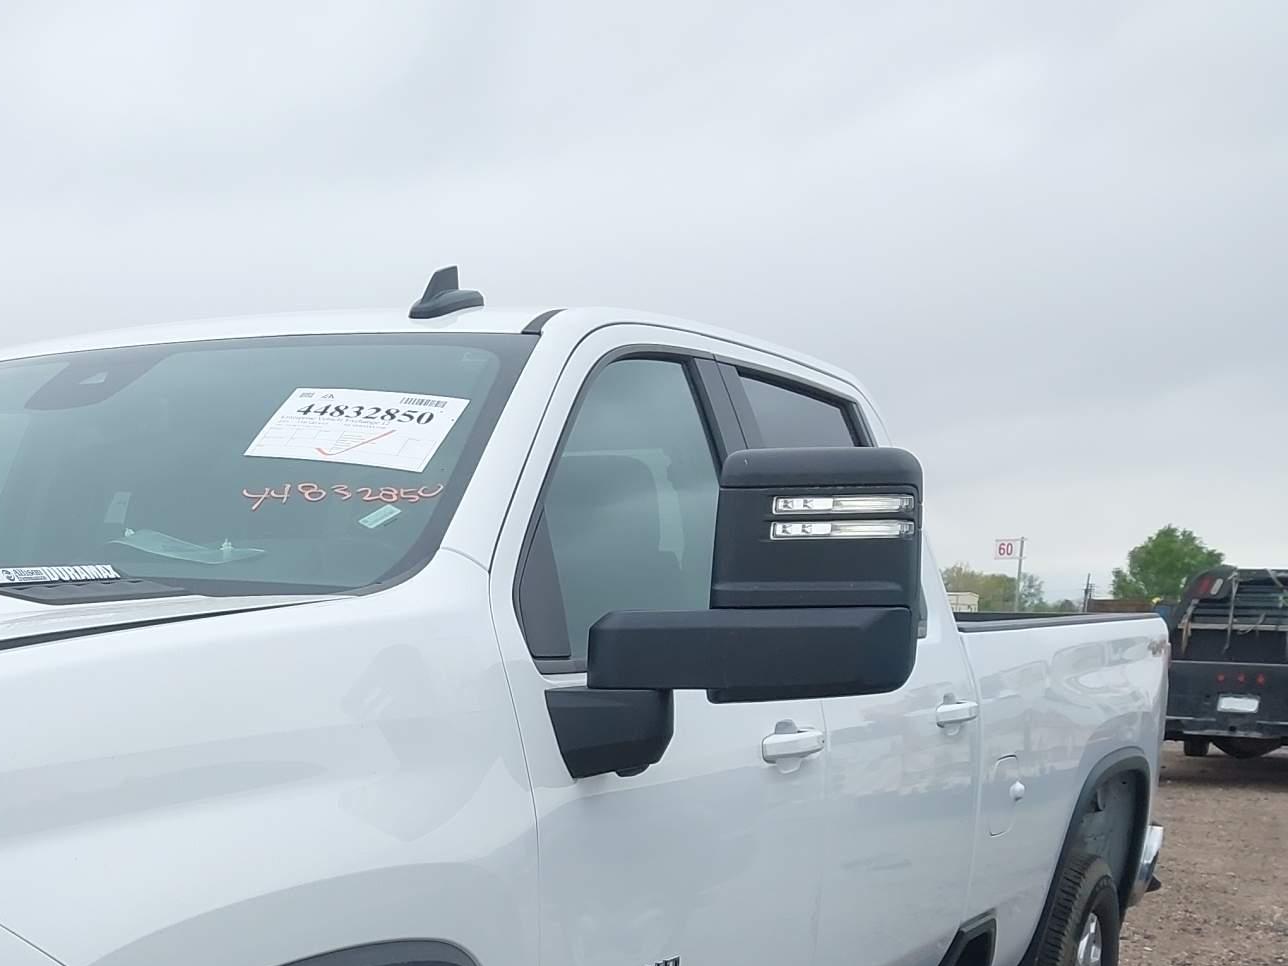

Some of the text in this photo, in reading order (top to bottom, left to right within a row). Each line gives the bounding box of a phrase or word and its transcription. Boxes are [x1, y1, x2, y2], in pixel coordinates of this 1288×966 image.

[296, 403, 435, 425] 44832850
[242, 482, 444, 511] 44832850
[998, 542, 1014, 556] 60
[45, 565, 121, 581] DURAMAX
